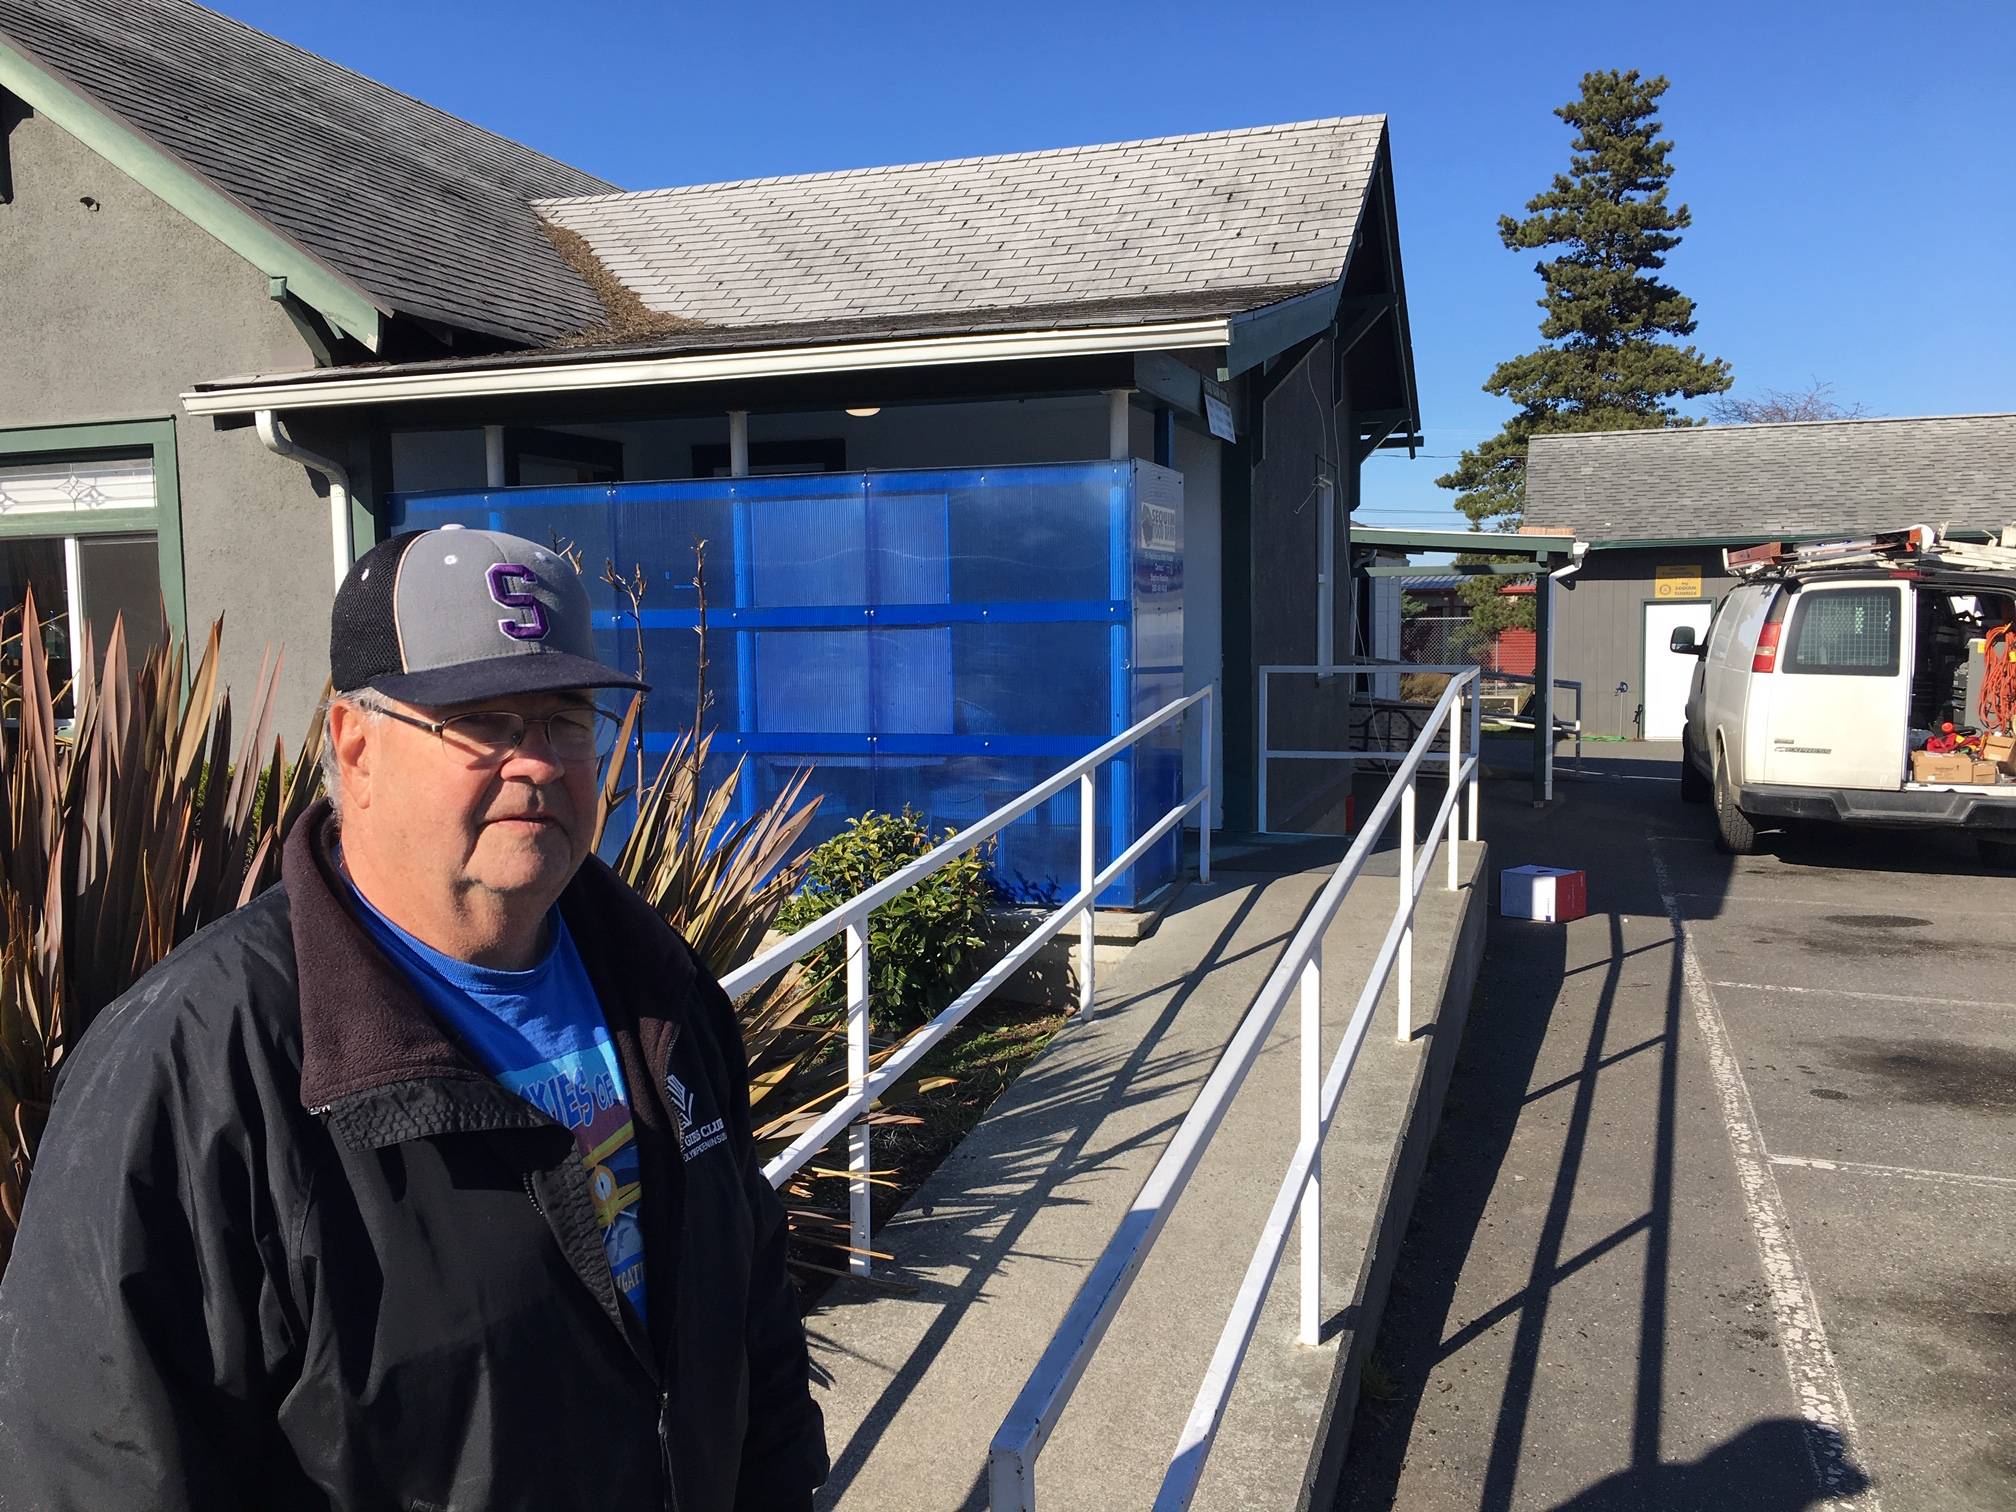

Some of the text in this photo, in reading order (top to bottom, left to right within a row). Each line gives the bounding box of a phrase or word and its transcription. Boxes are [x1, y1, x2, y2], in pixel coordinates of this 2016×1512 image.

[1152, 509, 1174, 527] SEQUIM
[485, 562, 551, 641] S
[519, 1066, 595, 1131] KIES
